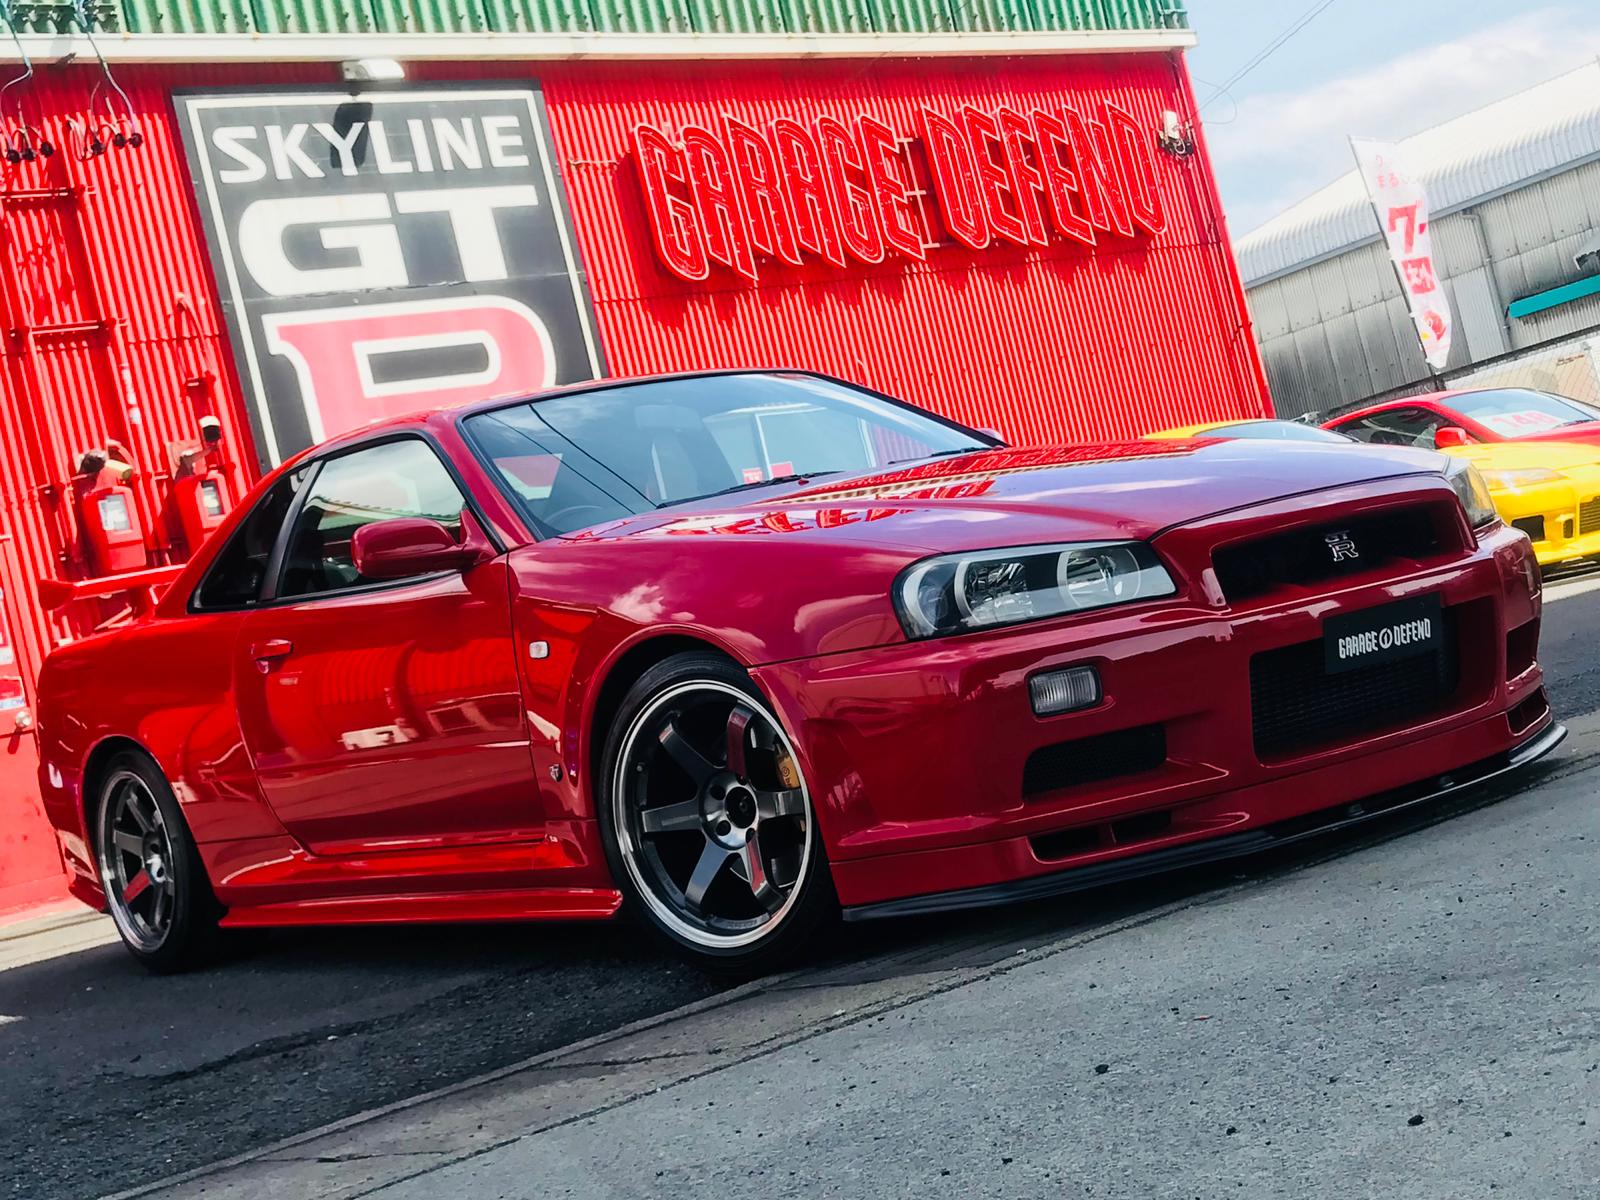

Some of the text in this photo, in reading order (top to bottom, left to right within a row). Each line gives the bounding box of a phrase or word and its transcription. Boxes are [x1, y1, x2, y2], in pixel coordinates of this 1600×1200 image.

[212, 116, 529, 183] SKYLINE
[631, 101, 1166, 281] GARAGE DEFEND
[238, 185, 539, 296] GT
[1339, 618, 1431, 659] GARAGE DEFEND
